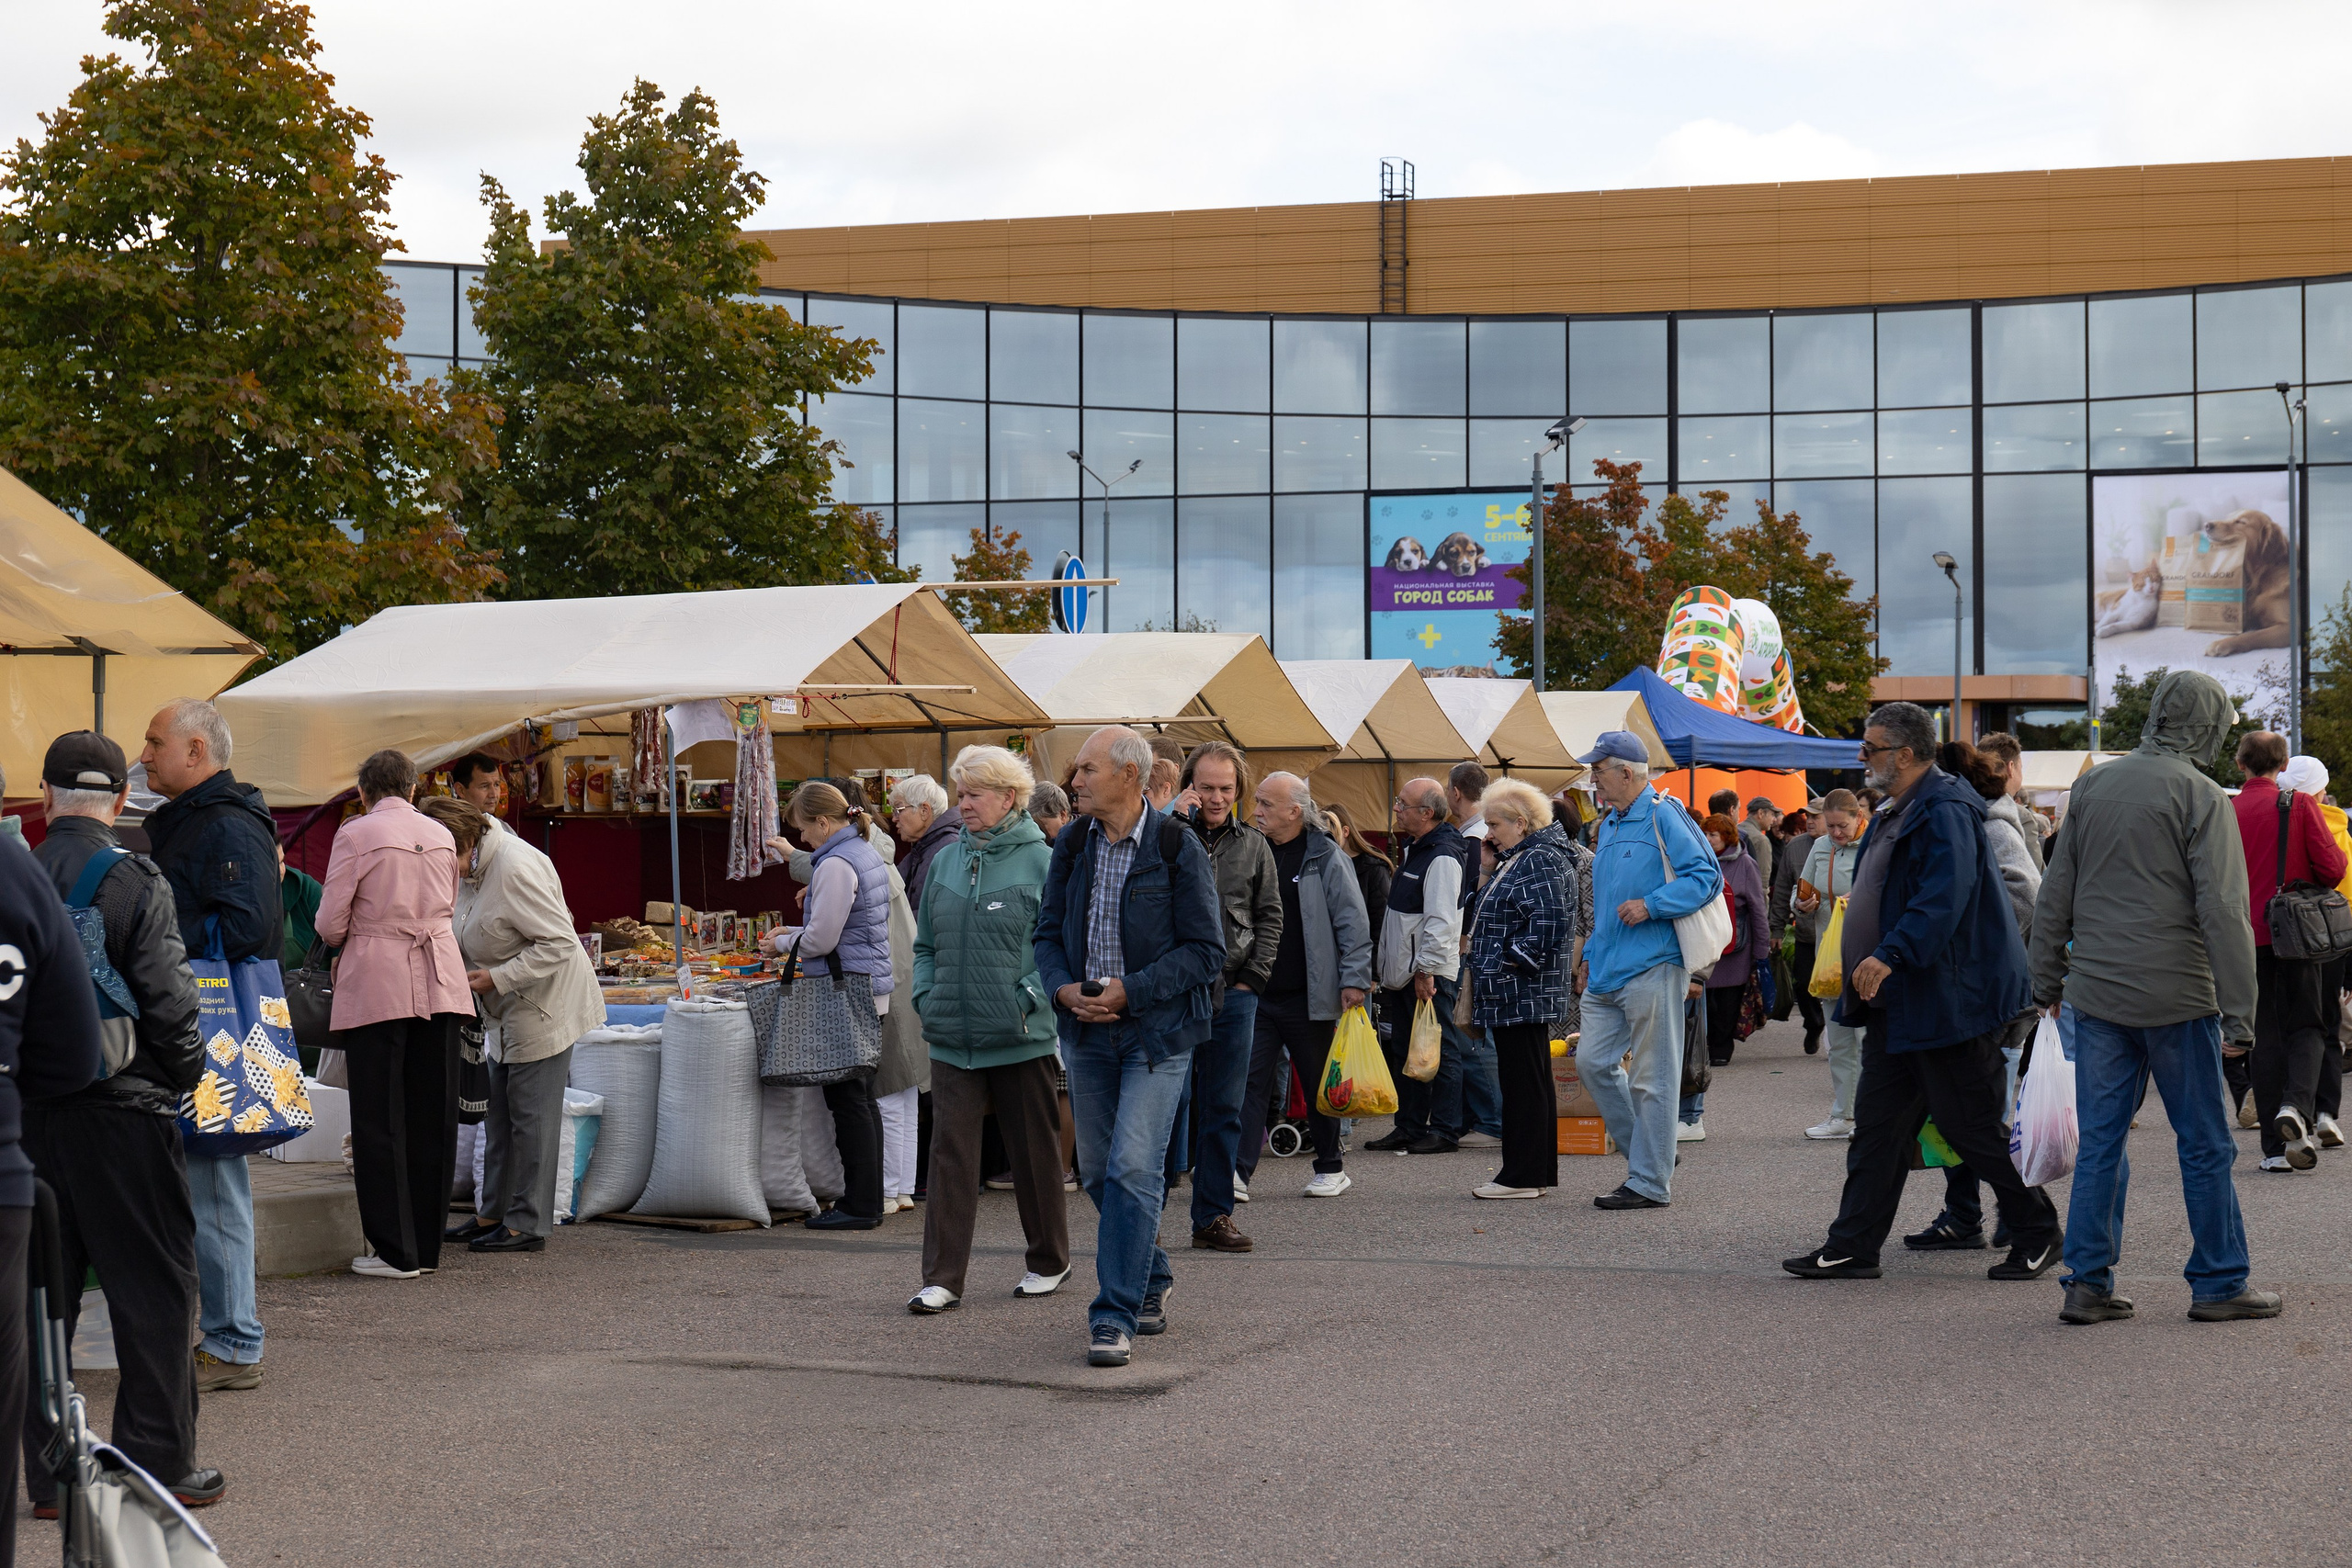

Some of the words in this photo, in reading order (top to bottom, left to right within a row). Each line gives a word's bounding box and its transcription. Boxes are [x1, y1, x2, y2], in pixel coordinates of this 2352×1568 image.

[1394, 591, 1443, 604] ГОРОД
[1446, 590, 1495, 603] СОБАК
[196, 977, 229, 987] ETRO
